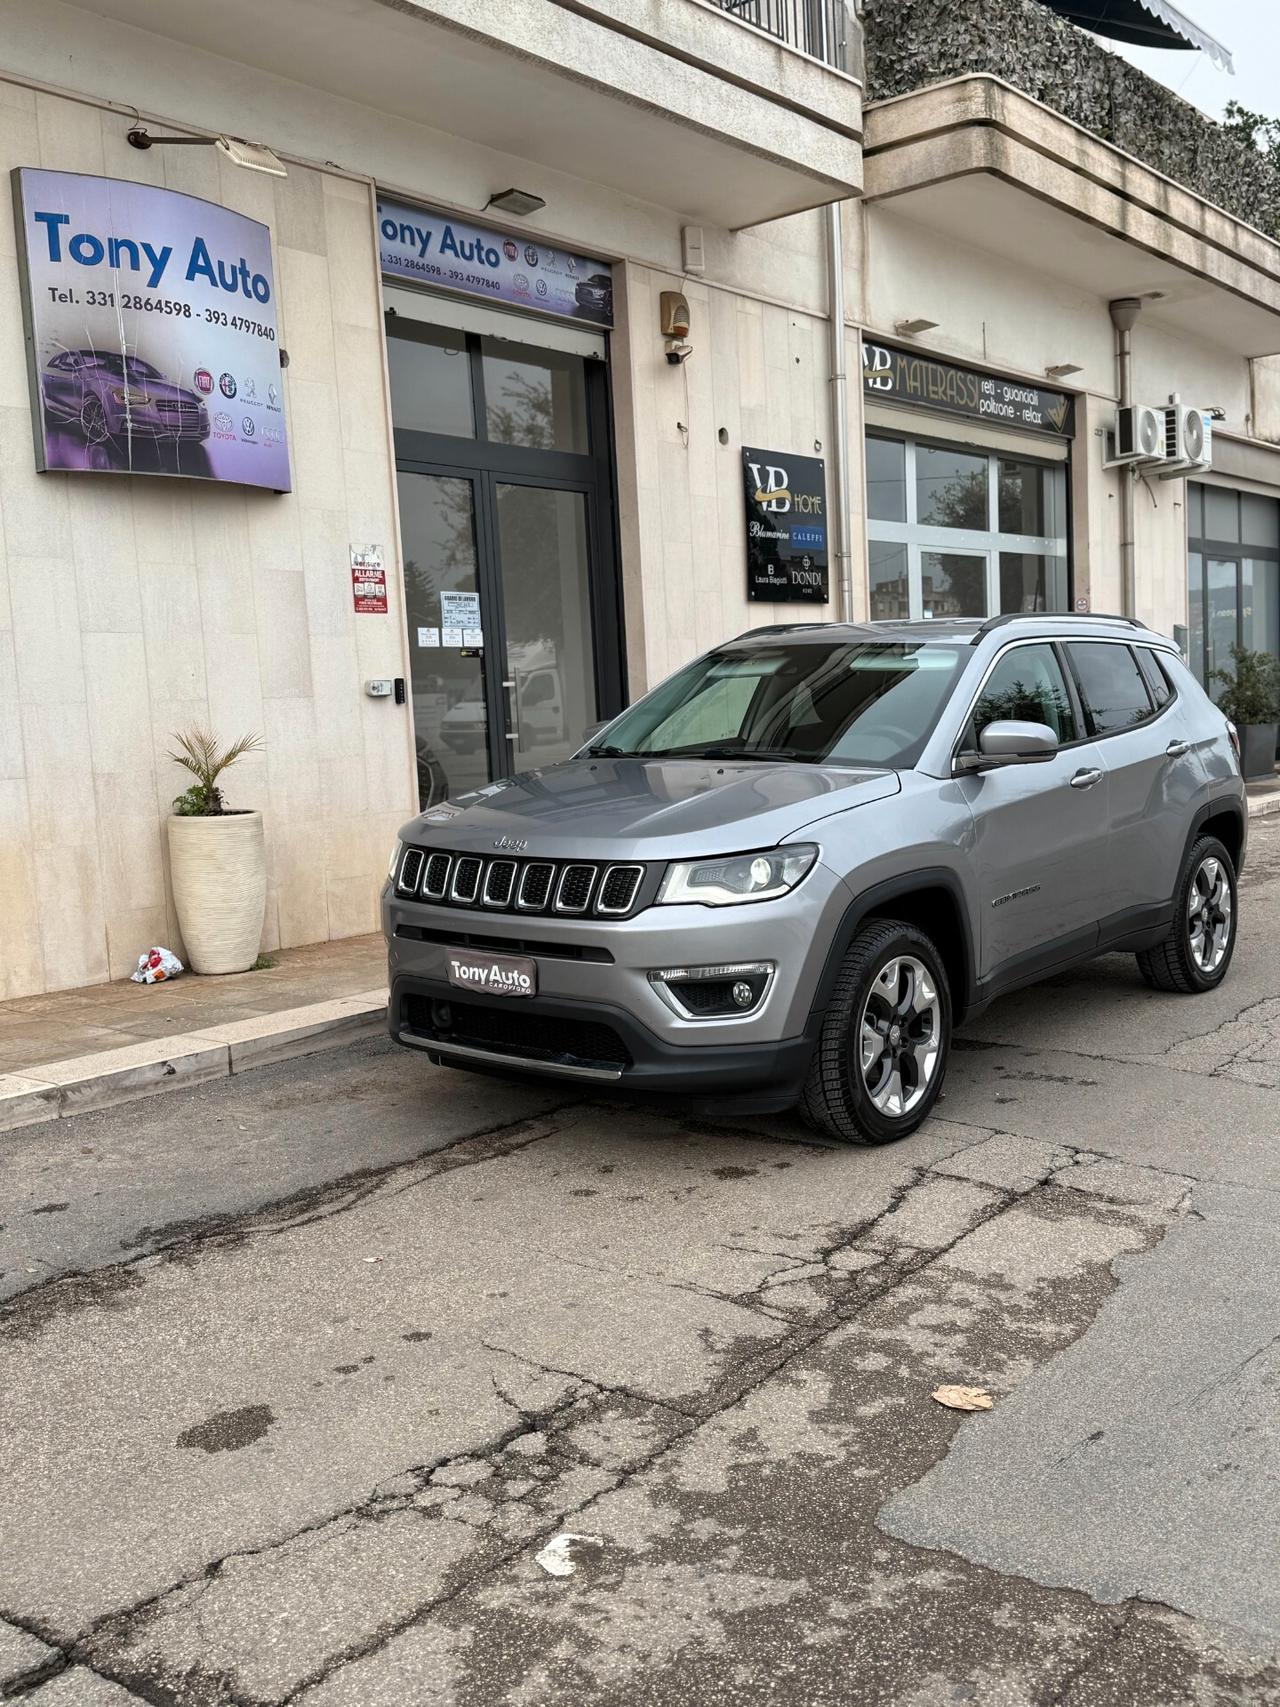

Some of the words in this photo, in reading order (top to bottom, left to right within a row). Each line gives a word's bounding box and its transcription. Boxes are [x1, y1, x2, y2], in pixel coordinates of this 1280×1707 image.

[377, 205, 432, 258] ony
[439, 224, 500, 269] Auto
[35, 211, 173, 288] Tony
[185, 236, 271, 304] Auto
[387, 254, 402, 266] 331
[404, 258, 442, 276] 2864598
[448, 269, 465, 282] 393
[465, 274, 500, 290] 4797840
[48, 287, 80, 305] Tel.
[86, 290, 115, 308] 331
[121, 295, 192, 318] 2864598
[205, 308, 228, 327] 393
[230, 317, 275, 341] 4797840
[896, 355, 980, 409] MATERASSI
[981, 380, 995, 395] reti
[1003, 386, 1039, 406] guanciali
[979, 398, 1015, 418] poltrone
[1022, 405, 1042, 425] relax
[213, 432, 237, 441] TOYOTA
[794, 493, 822, 514] HOME
[792, 532, 823, 542] CALEFFI
[755, 575, 769, 584] Laura
[767, 564, 775, 575] B
[792, 570, 822, 586] DONDI
[493, 836, 528, 852] Jeep
[488, 982, 531, 994] CAROVIGNO
